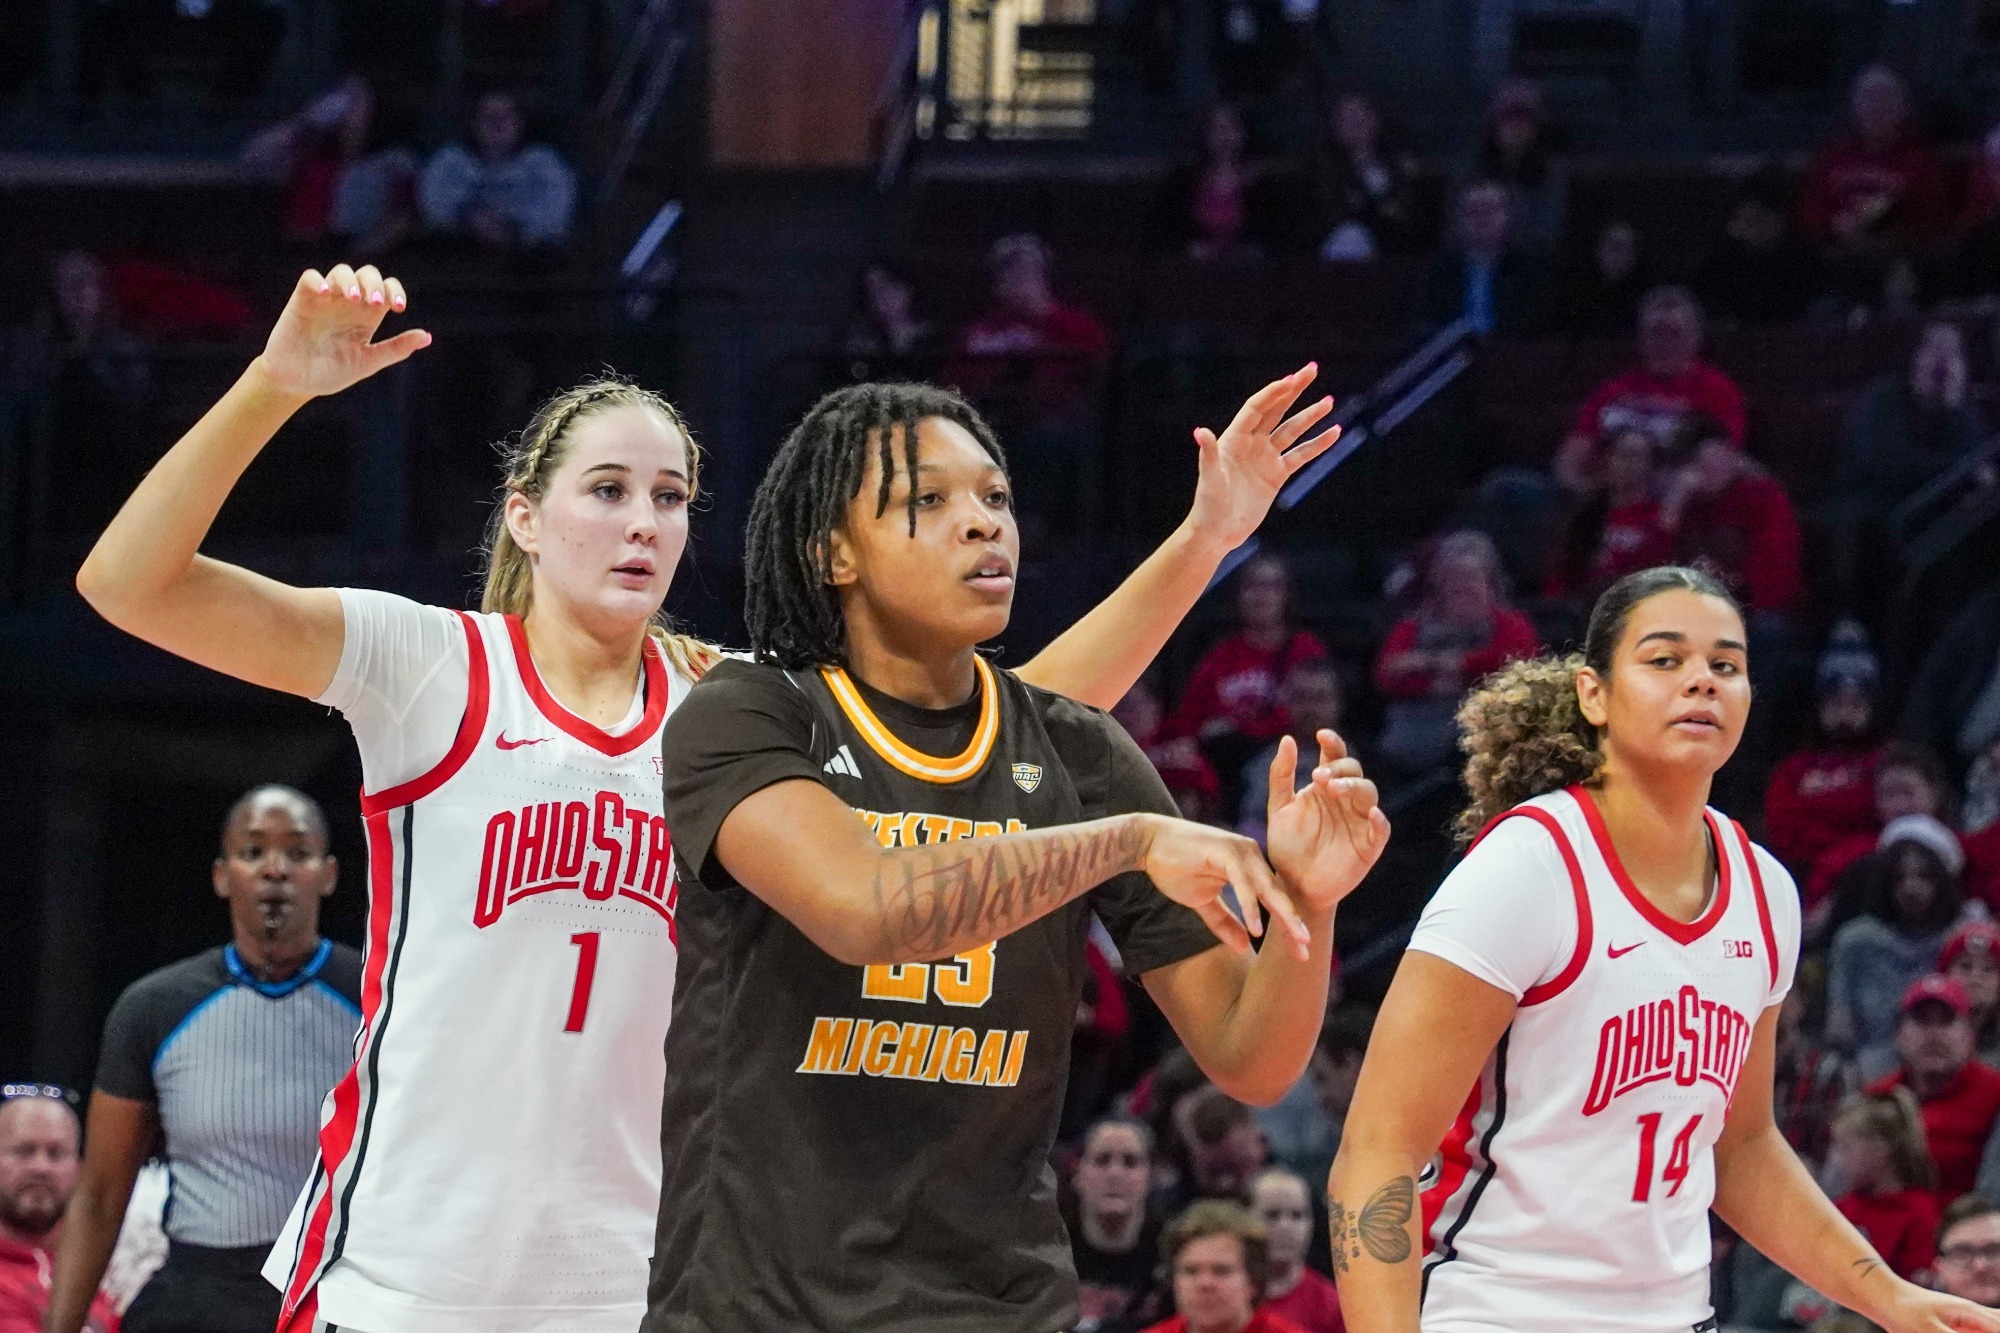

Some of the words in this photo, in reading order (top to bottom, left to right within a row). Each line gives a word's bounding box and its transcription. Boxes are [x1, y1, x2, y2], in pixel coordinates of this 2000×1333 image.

[1012, 771, 1039, 781] MAC
[849, 807, 1027, 849] ESTE
[582, 790, 678, 955] STA
[563, 931, 601, 1033] 1
[795, 1016, 1029, 1087] MICHIGAN
[1631, 1111, 1704, 1203] 14
